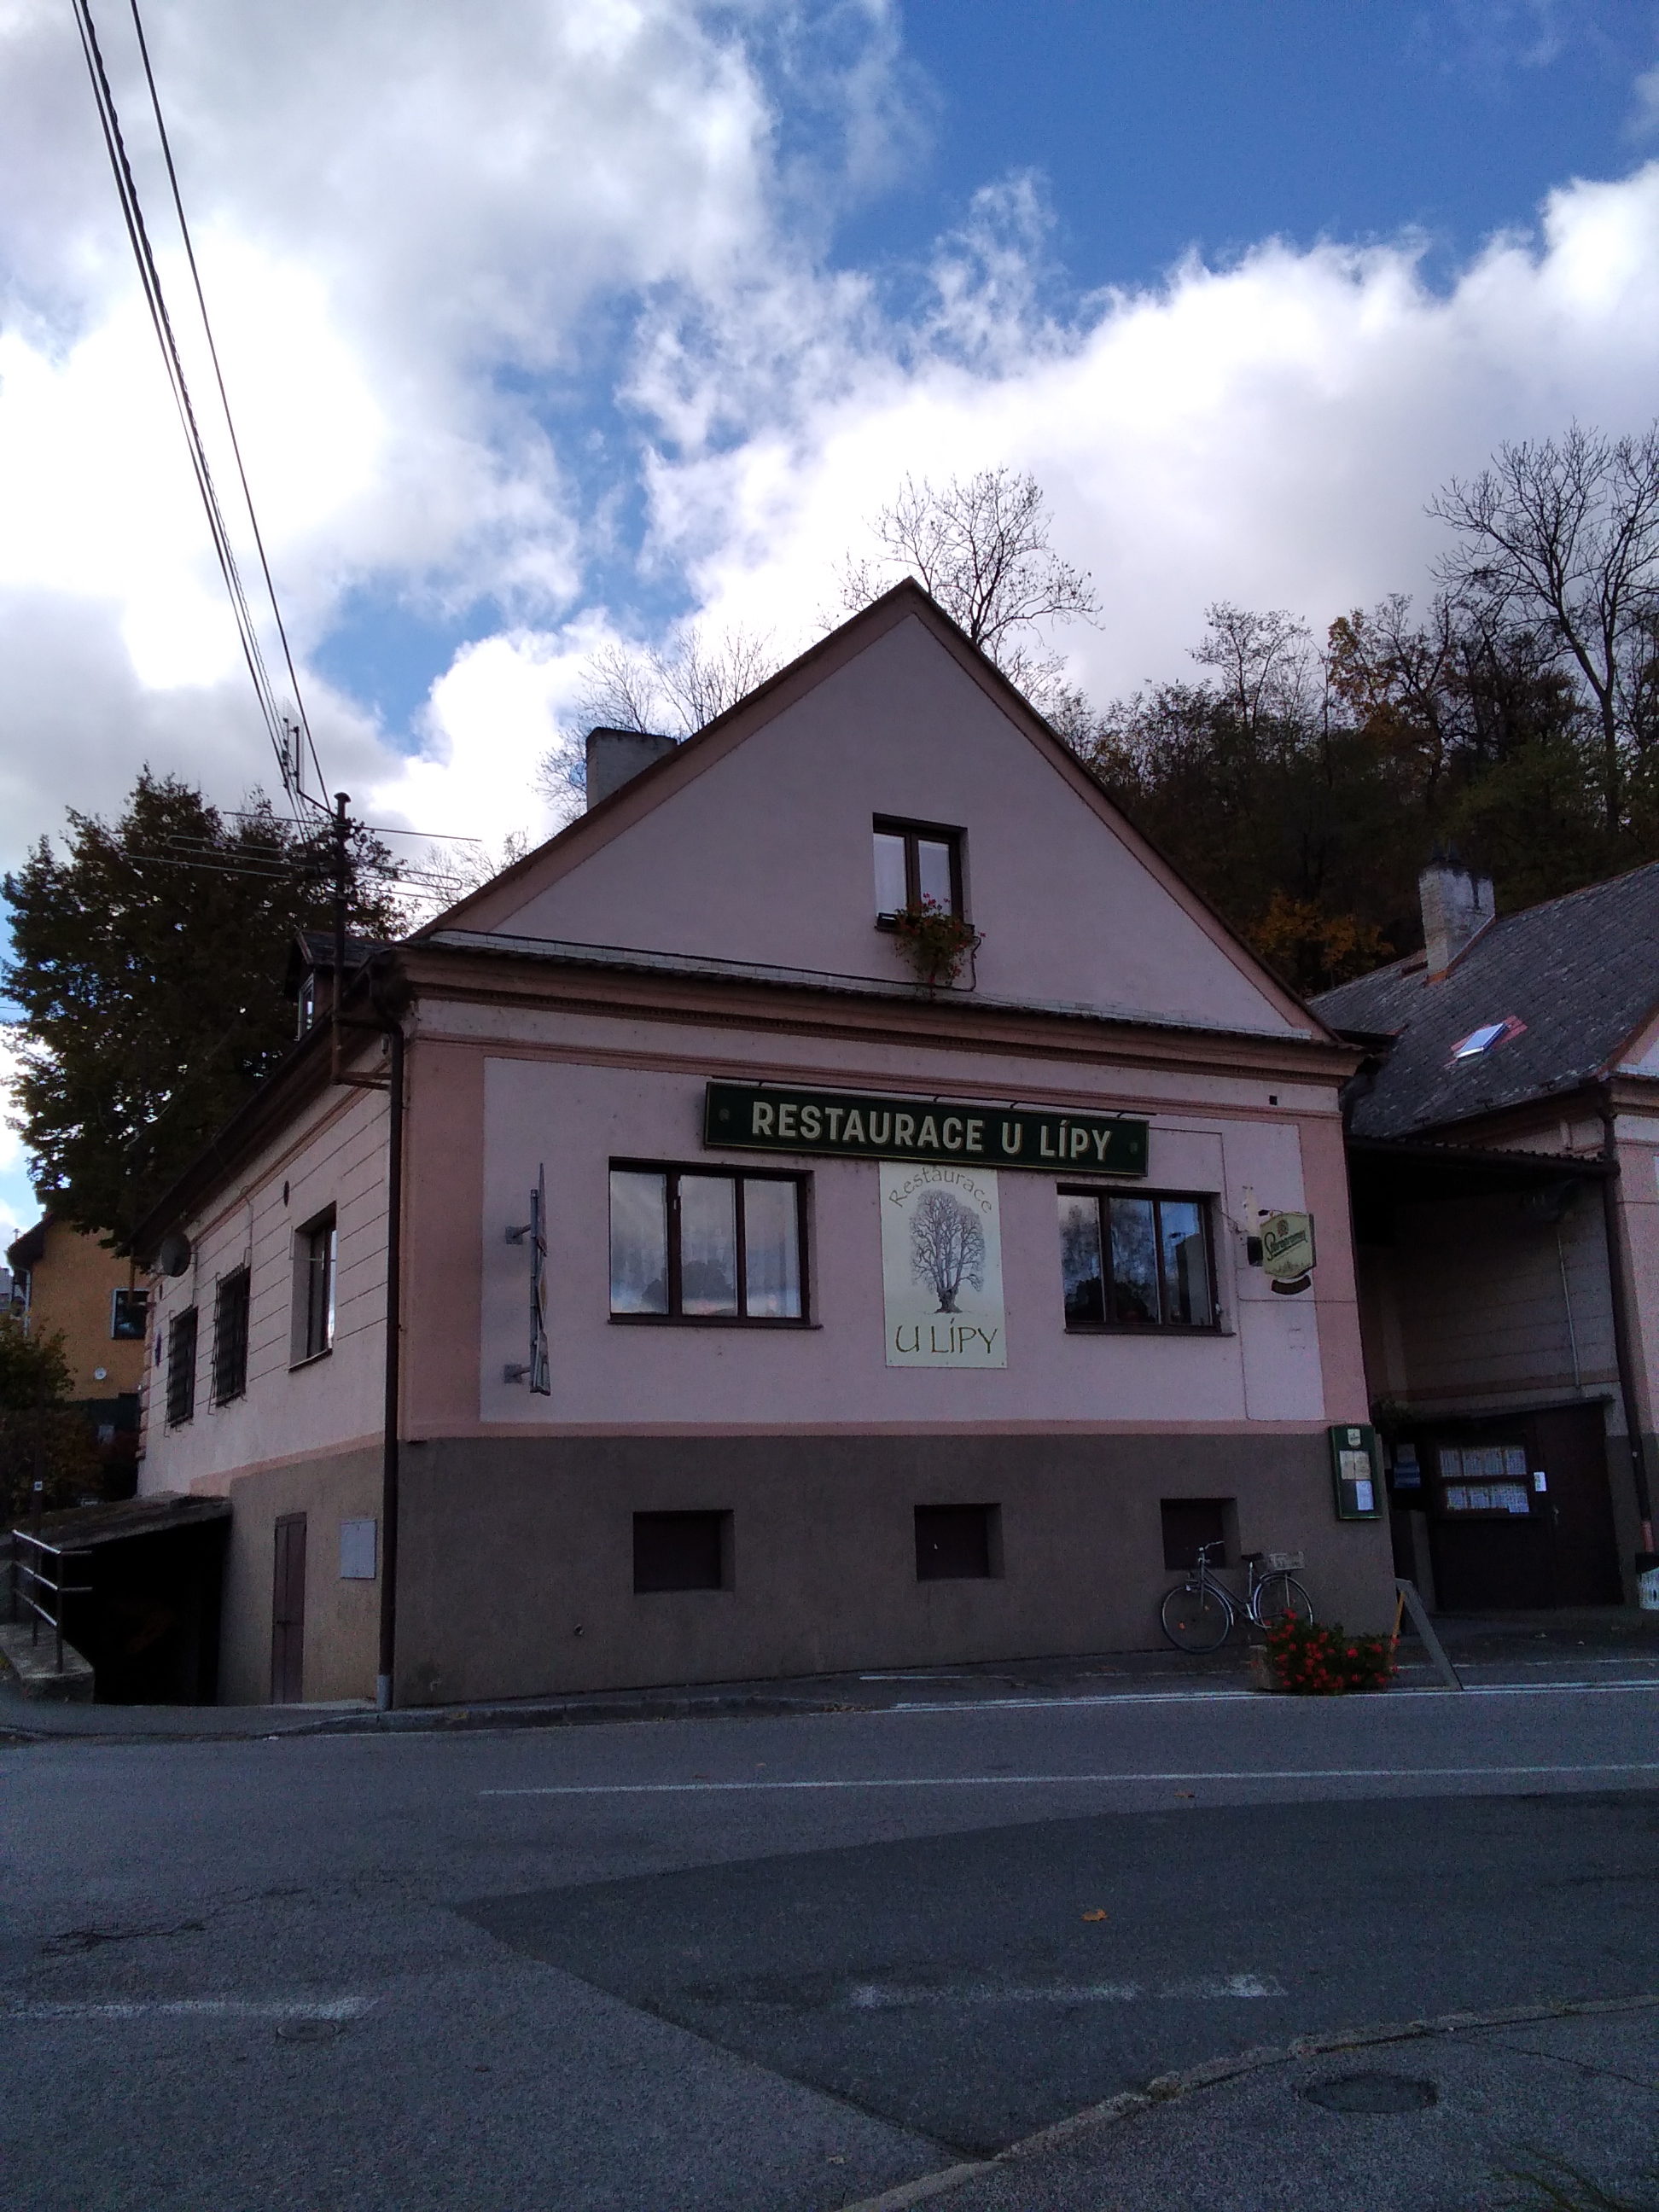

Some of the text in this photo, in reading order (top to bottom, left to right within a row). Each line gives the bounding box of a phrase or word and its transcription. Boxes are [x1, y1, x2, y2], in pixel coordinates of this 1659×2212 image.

[751, 1101, 1112, 1161] RESTAURACE U LÍPY
[888, 1166, 992, 1213] Restaurace
[895, 1317, 998, 1354] U LÍPY
